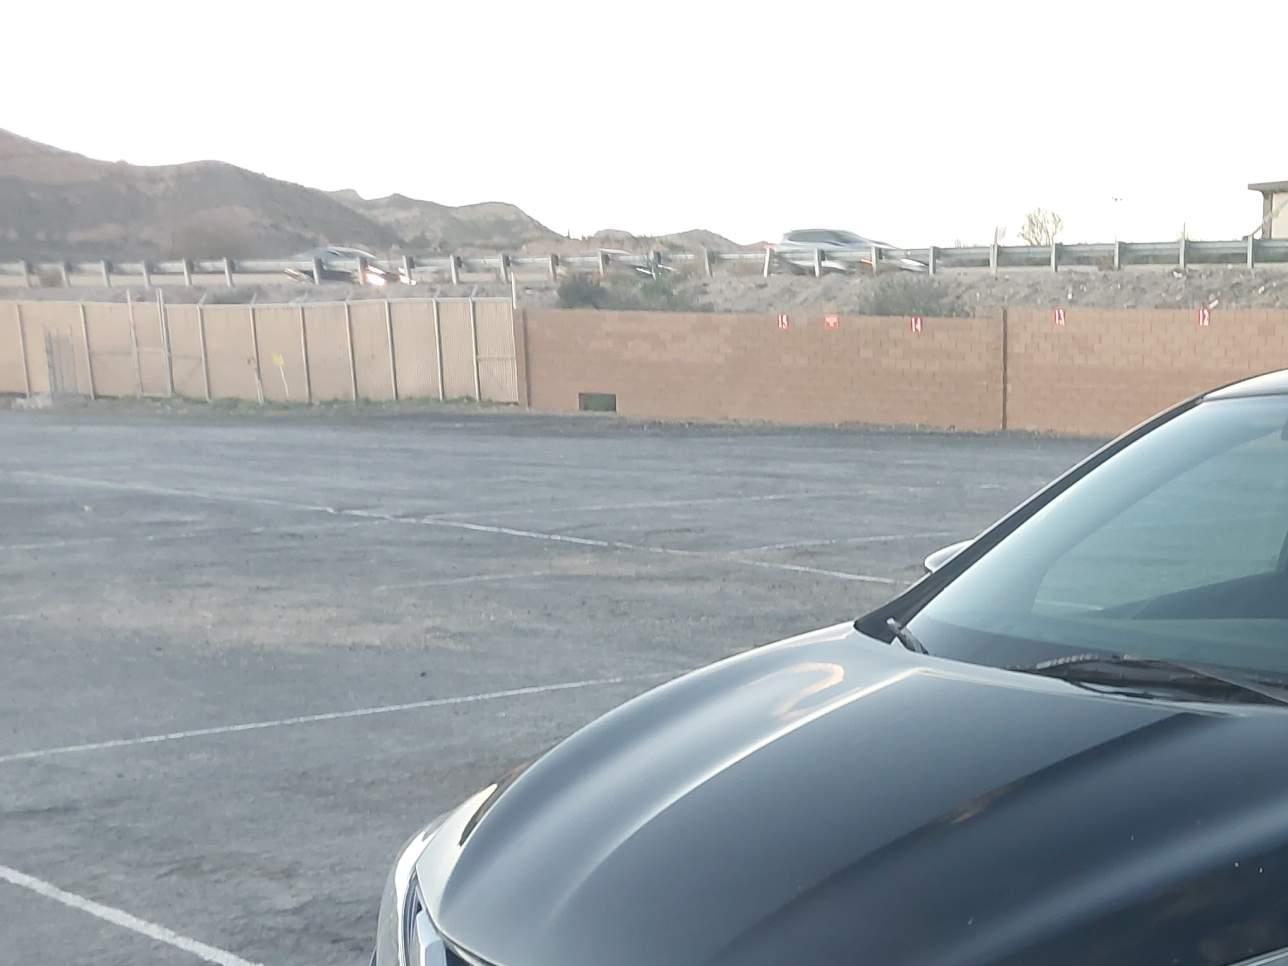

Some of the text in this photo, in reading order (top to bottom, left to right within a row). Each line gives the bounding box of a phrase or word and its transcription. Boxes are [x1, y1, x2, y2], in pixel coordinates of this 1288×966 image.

[911, 316, 922, 332] 14
[1055, 309, 1065, 326] 13
[1199, 309, 1209, 326] 12
